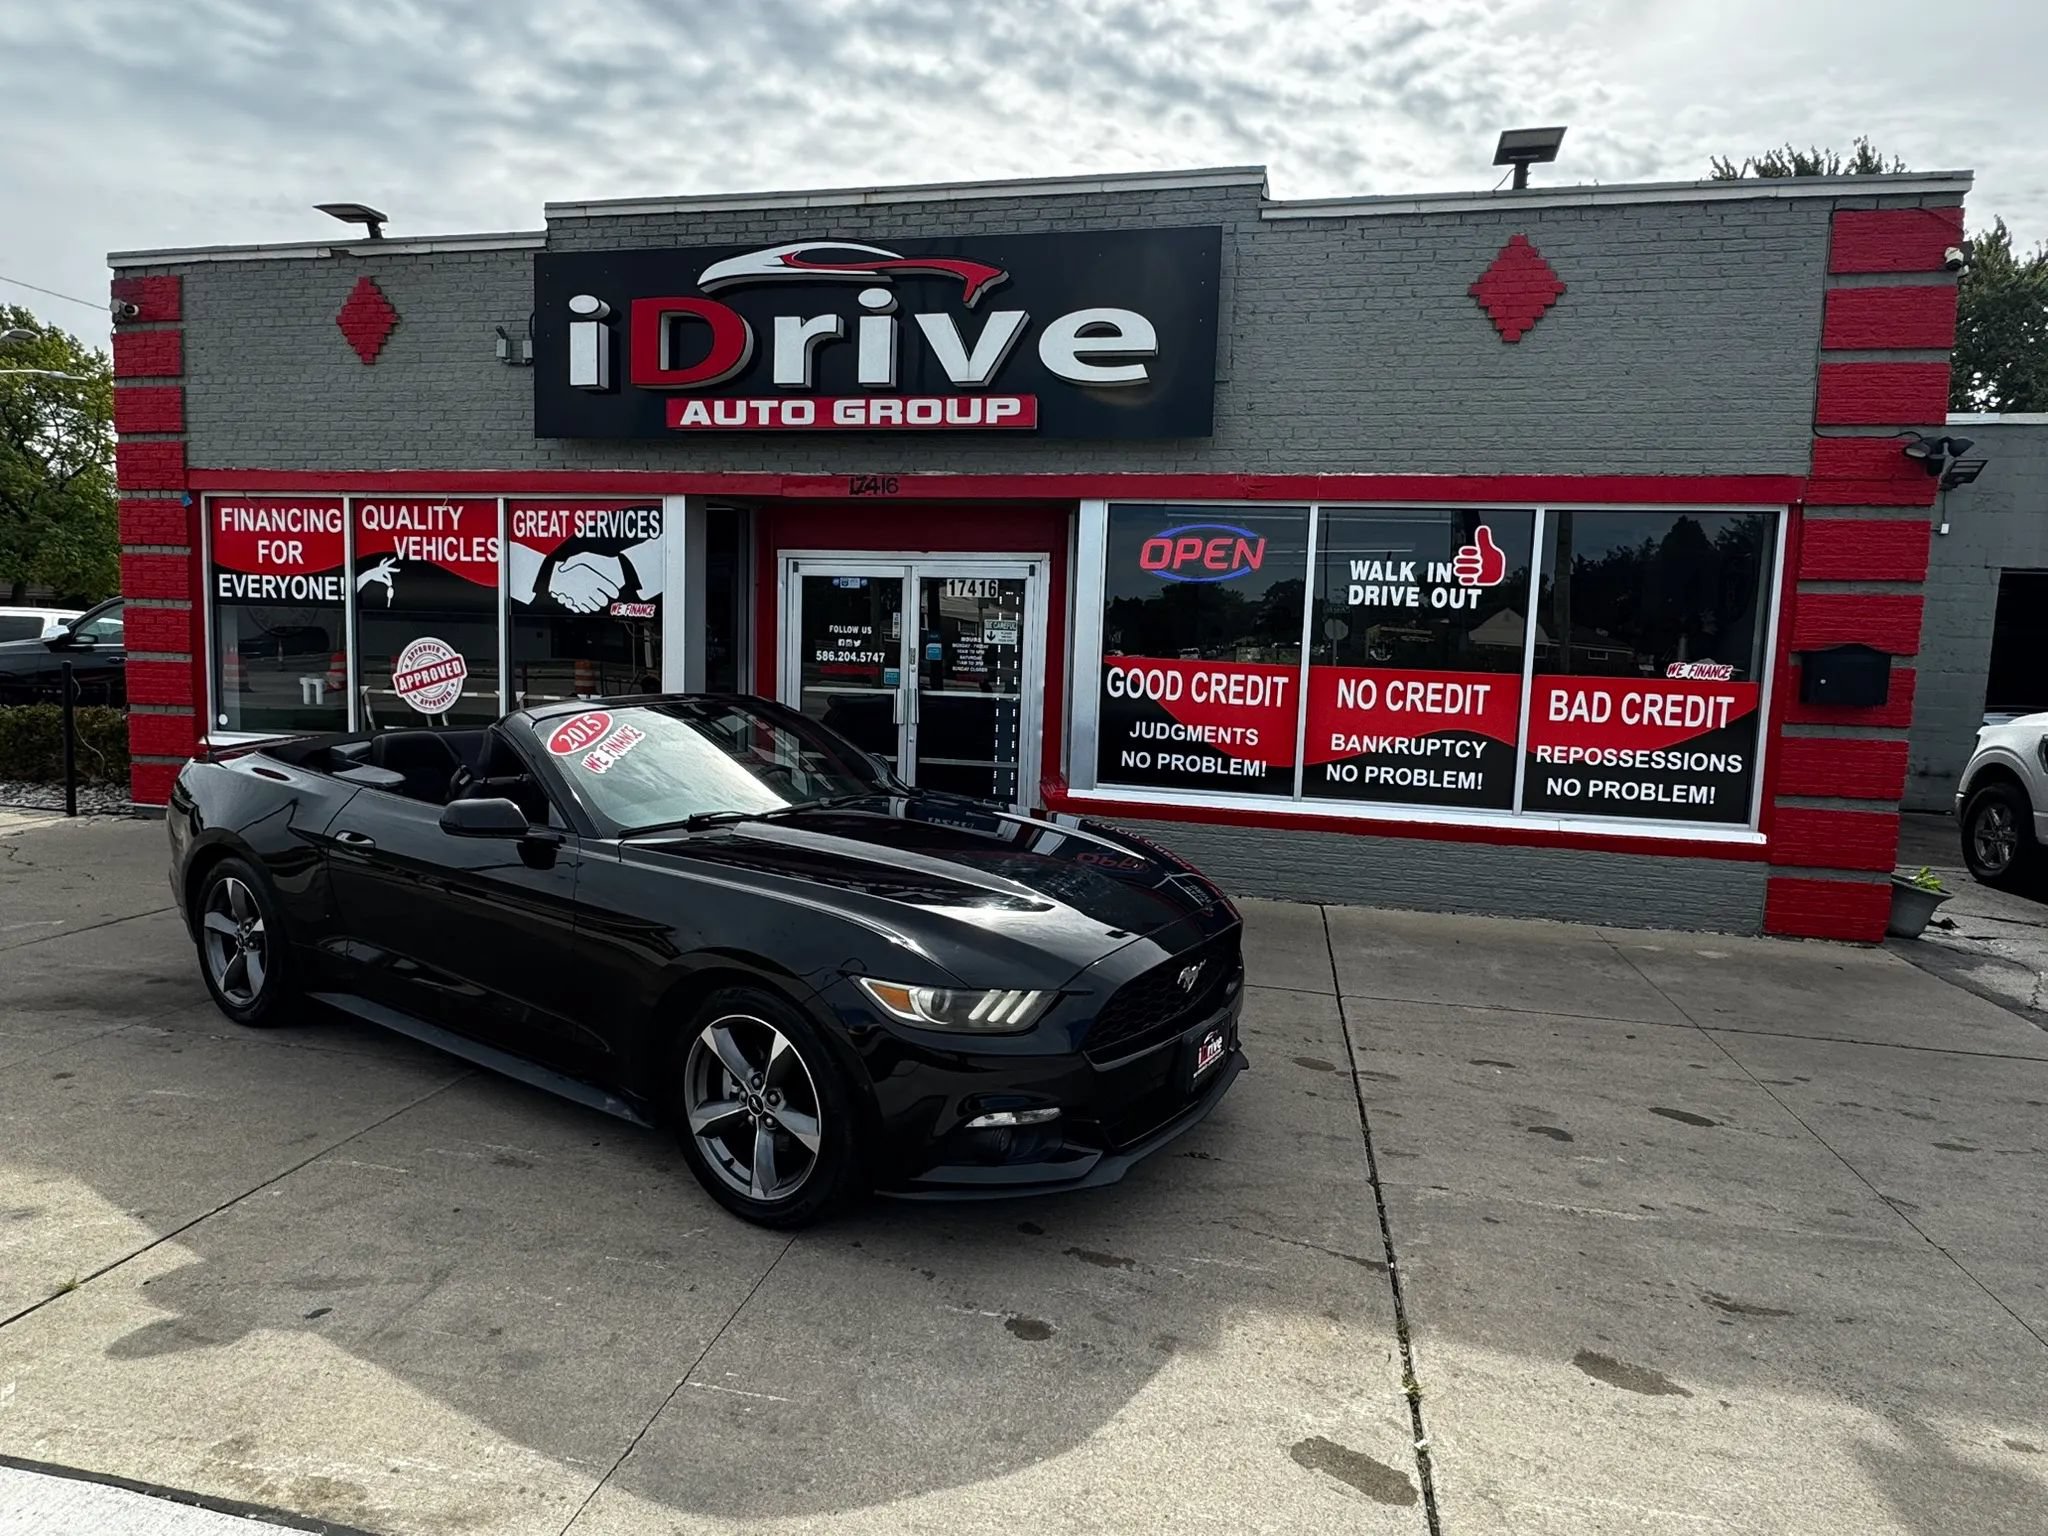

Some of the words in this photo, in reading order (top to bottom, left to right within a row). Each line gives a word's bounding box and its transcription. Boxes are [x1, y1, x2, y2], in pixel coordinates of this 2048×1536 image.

[568, 287, 1159, 390] iDrive
[680, 399, 816, 427] AUTO
[833, 396, 1021, 426] GROUP
[220, 507, 342, 534] FINANCING
[361, 505, 464, 532] QUALITY
[513, 510, 570, 538] GREAT
[574, 511, 661, 540] SERVICES
[258, 540, 304, 565] FOR
[393, 536, 499, 563] VEHICLES
[1139, 537, 1266, 571] OPEN
[1350, 559, 1415, 583] WALK
[1427, 561, 1453, 583] IN
[219, 574, 345, 601] EVERYONE!
[949, 579, 997, 597] 17416
[1348, 585, 1420, 608] DRIVE
[1431, 587, 1482, 610] OUT
[611, 603, 622, 615] WE
[625, 603, 655, 617] FINANCE
[829, 624, 859, 635] FOLLOW
[861, 625, 872, 635] US
[407, 644, 440, 662] APPROVED
[816, 650, 886, 663] 586.204.5747
[399, 660, 462, 692] APPROVED
[1666, 662, 1685, 678] WE
[1687, 663, 1733, 681] FINANCE
[420, 690, 452, 707] APPROVED
[1106, 666, 1184, 701] GOOD
[1191, 671, 1289, 708] CREDIT
[1337, 678, 1376, 711] NO
[1385, 681, 1491, 716] CREDIT
[1549, 689, 1611, 725] BAD
[1621, 692, 1735, 729] CREDIT
[558, 714, 602, 751] 2015
[1129, 720, 1259, 747] JUDGMENTS
[584, 753, 609, 772] WE
[600, 725, 643, 758] FINANCE
[1330, 733, 1488, 760] BANKRUPTCY
[1536, 745, 1742, 774] REPOSSESSIONS
[1121, 750, 1152, 769] NO
[1157, 752, 1267, 778] PROBLEM!
[1326, 763, 1359, 783] NO
[1364, 765, 1483, 791] PROBLEM!
[1546, 778, 1581, 797] NO
[1588, 779, 1716, 805] PROBLEM!
